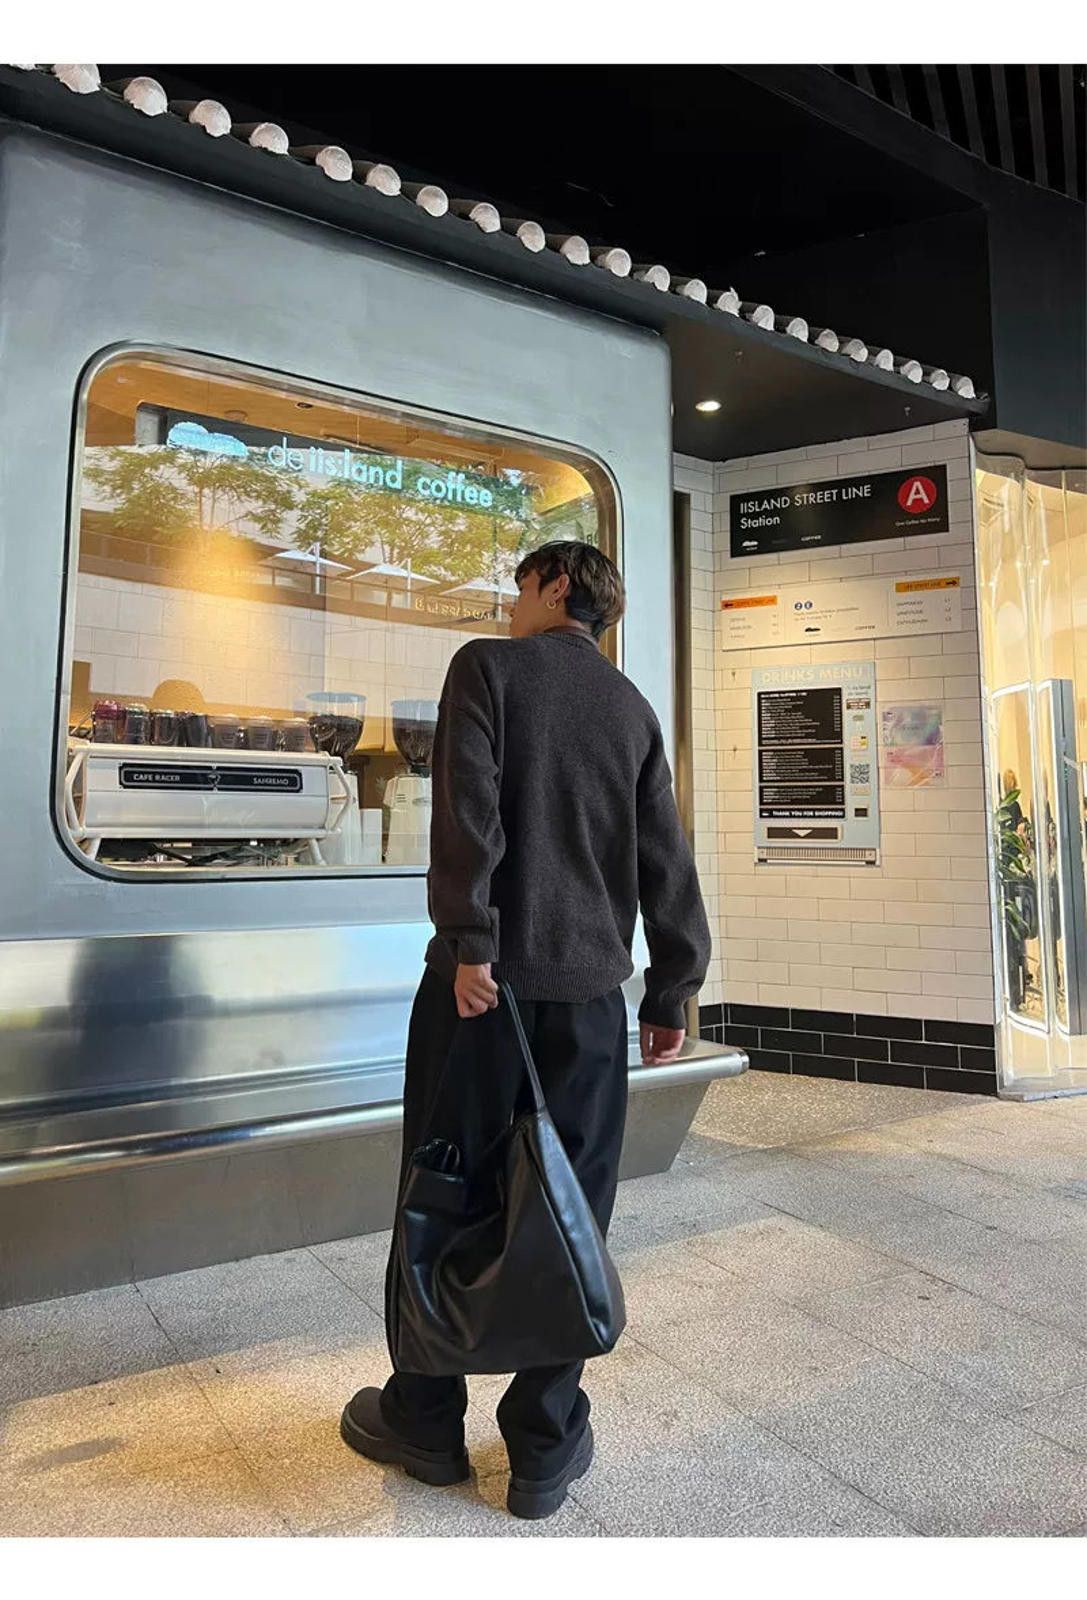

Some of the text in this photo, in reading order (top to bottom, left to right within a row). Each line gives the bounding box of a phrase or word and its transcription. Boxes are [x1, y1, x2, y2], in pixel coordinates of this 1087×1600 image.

[267, 436, 303, 470] de
[416, 471, 493, 508] coffee
[740, 484, 872, 514] IISLAND STREET LINE
[906, 480, 930, 506] A
[740, 515, 780, 530] Station
[762, 667, 862, 683] DRINKS MENU
[154, 774, 181, 782] RACER
